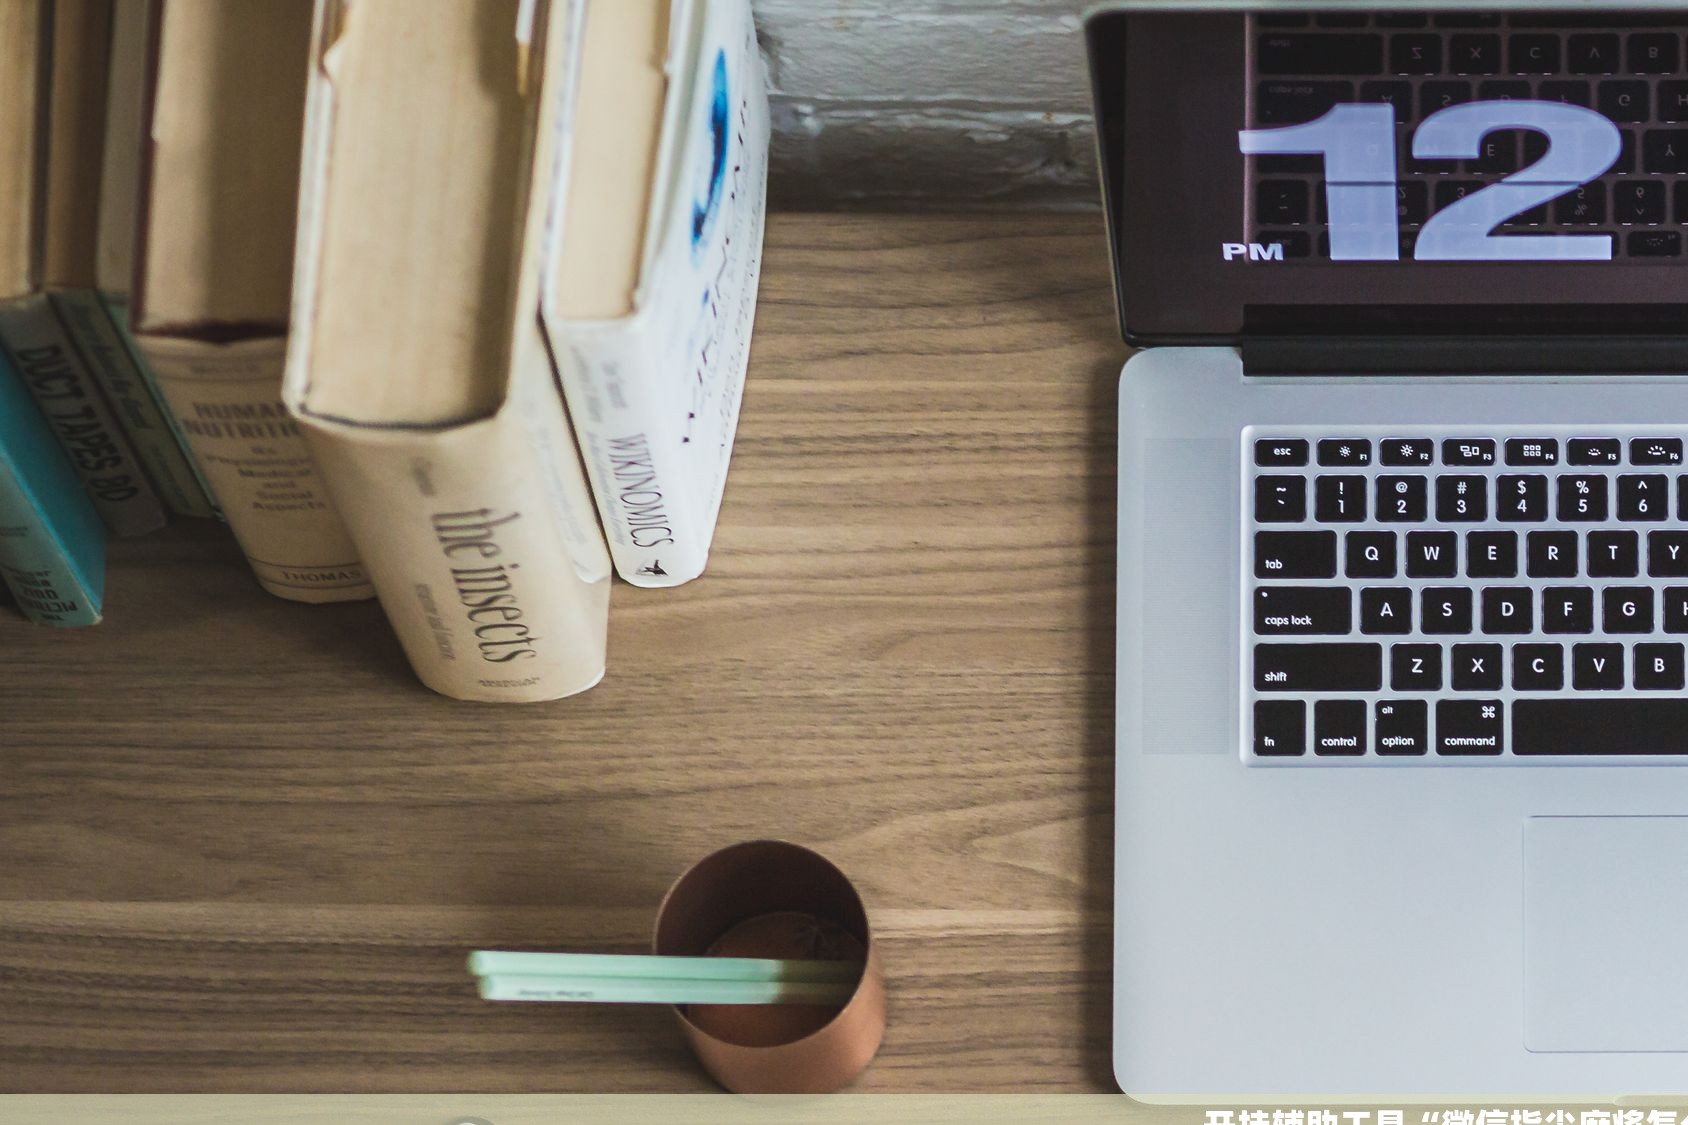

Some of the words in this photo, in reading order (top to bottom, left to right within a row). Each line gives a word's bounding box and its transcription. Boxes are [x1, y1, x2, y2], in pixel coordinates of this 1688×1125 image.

[1238, 98, 1624, 262] 12
[1222, 243, 1283, 261] PM
[1338, 499, 1344, 513] 1
[1397, 500, 1407, 513] 2
[1457, 499, 1466, 513] 3
[1517, 499, 1527, 512] 4
[1578, 499, 1587, 512] 5
[1639, 499, 1648, 512] 6
[430, 506, 520, 559] the
[1365, 546, 1379, 561] Q
[1424, 546, 1440, 560] W
[1488, 546, 1497, 560] E
[1548, 546, 1558, 560] R
[1608, 545, 1618, 560] T
[1669, 545, 1679, 560] Y
[1265, 559, 1283, 569] tab
[449, 563, 541, 664] insects
[1380, 602, 1393, 617] A
[1442, 602, 1452, 616] S
[1502, 602, 1514, 616] D
[1564, 602, 1573, 616] F
[1622, 602, 1635, 616] G
[1265, 616, 1290, 628] caps
[1291, 615, 1312, 626] lock
[1412, 658, 1423, 673] Z
[1472, 658, 1484, 673] X
[1532, 658, 1544, 673] C
[1593, 658, 1605, 673] V
[1654, 658, 1665, 672] B
[1265, 671, 1287, 682] shift
[1382, 706, 1393, 714] alt
[1264, 736, 1275, 746] fn
[1321, 736, 1357, 746] control
[1382, 736, 1414, 748] option
[1444, 736, 1495, 746] command
